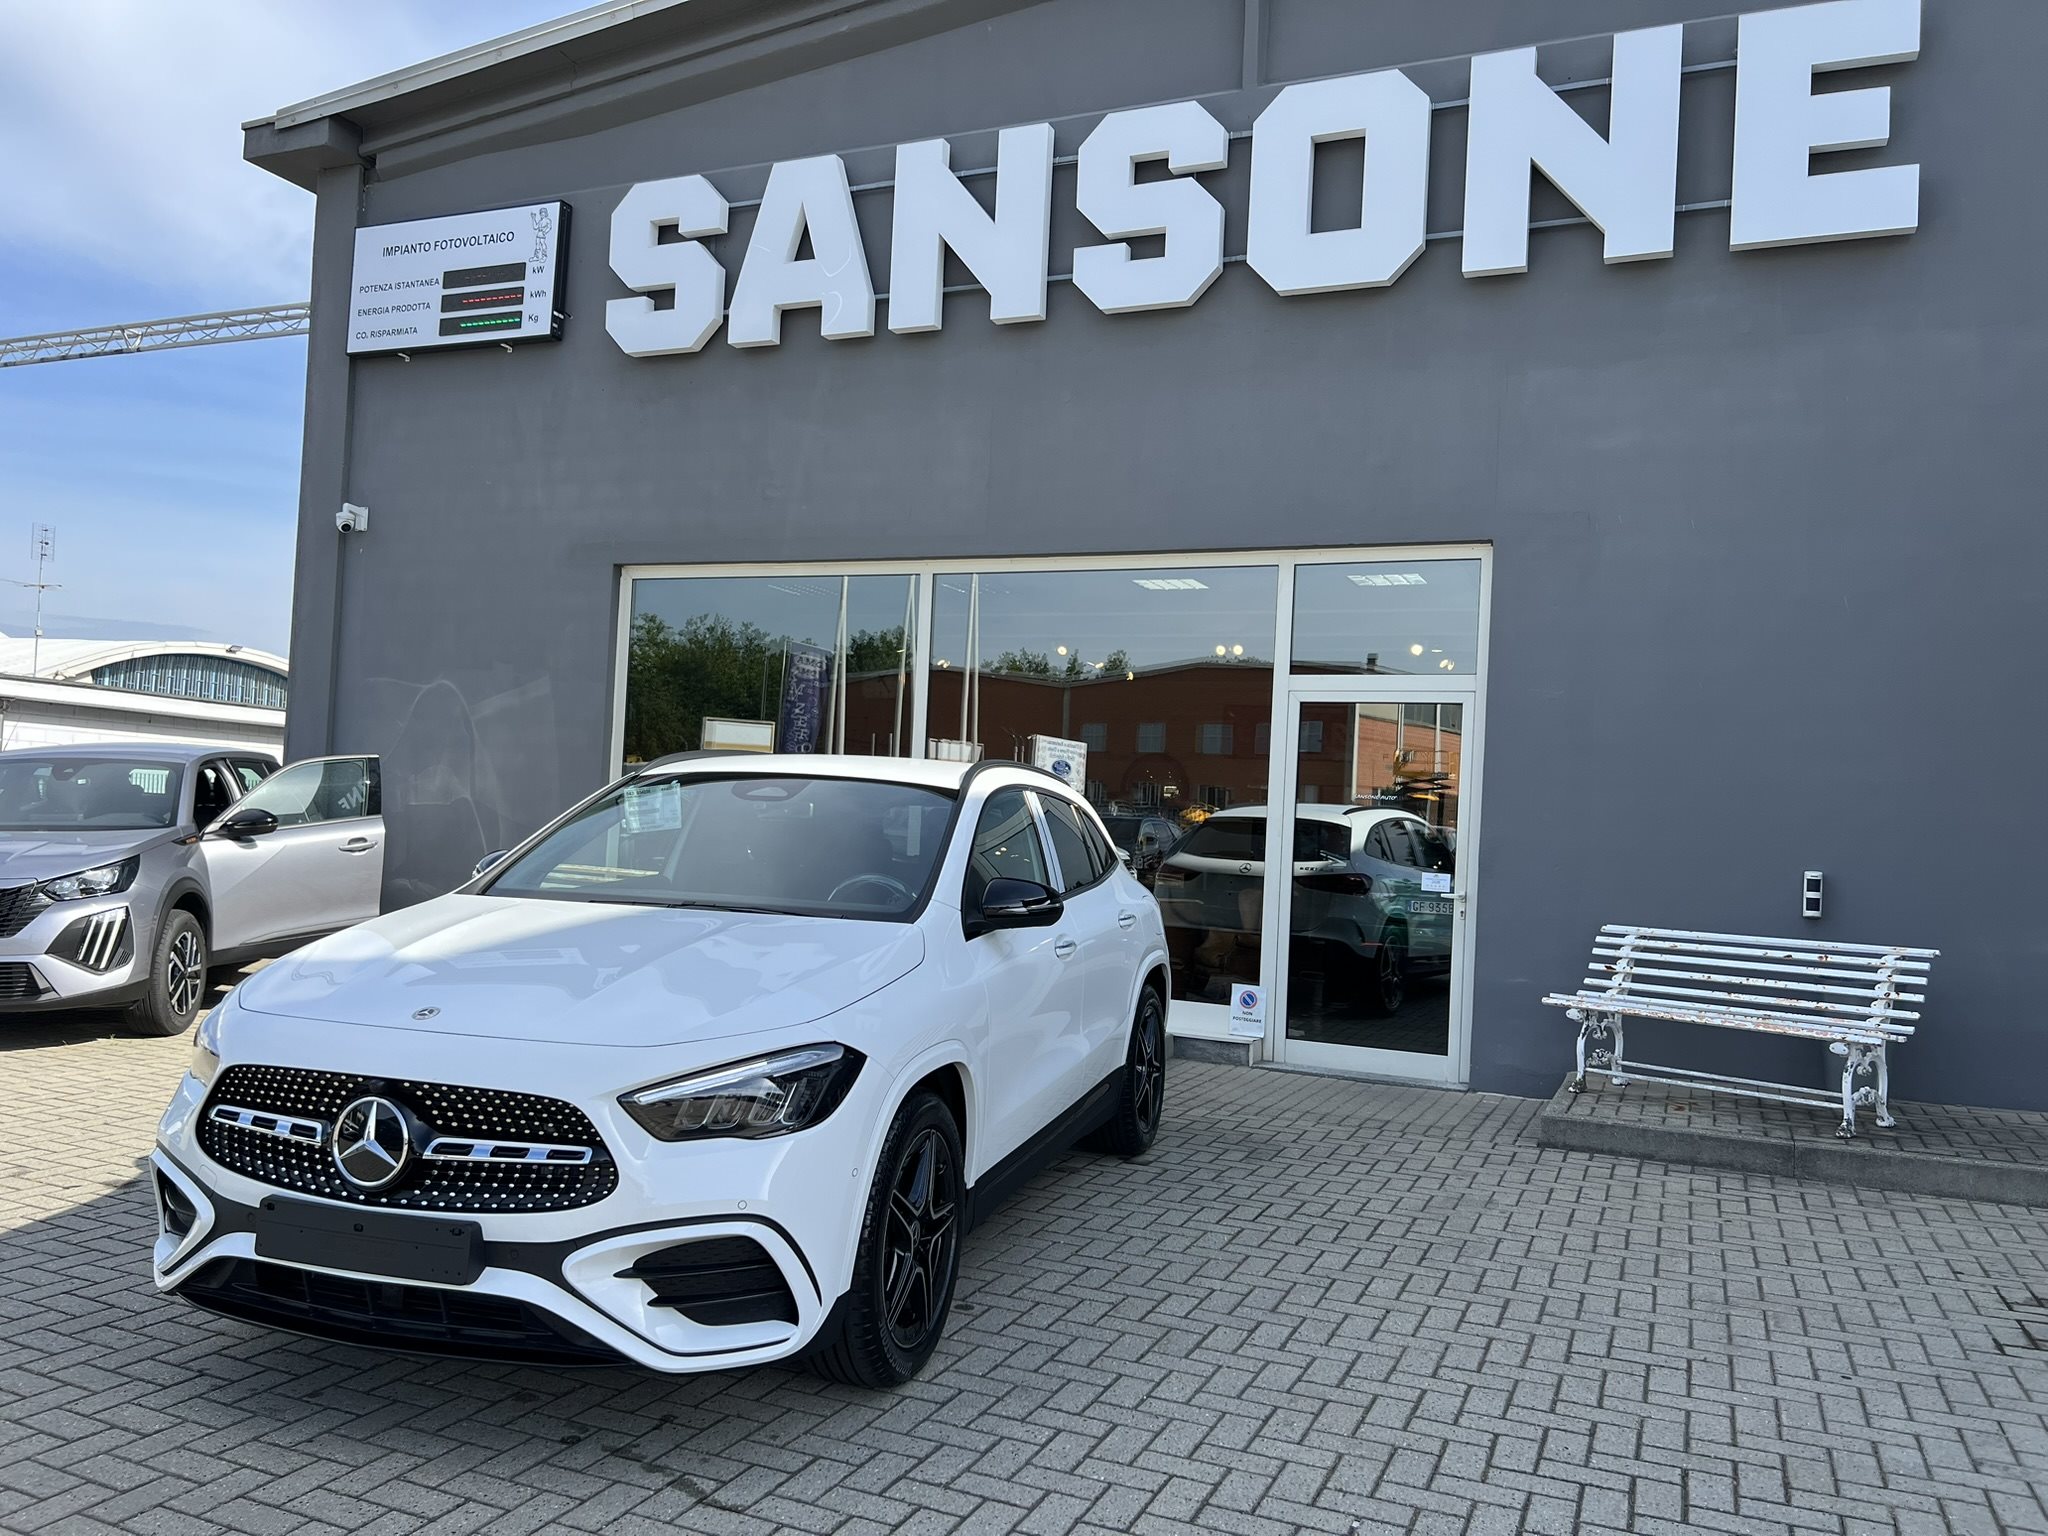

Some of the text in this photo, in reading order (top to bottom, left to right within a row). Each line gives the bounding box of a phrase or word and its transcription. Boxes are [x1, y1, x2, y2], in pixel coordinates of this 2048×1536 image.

[605, 0, 1922, 358] SANSONE
[382, 231, 515, 257] IMPIANTO FOTOVOLTAICO
[532, 265, 545, 274] kW
[359, 278, 440, 294] POTENZA ISTANTANEA
[530, 290, 547, 299] kWh
[357, 302, 431, 317] ENERGIA PRODOTTA
[528, 313, 539, 323] Kg
[370, 326, 418, 338] RISPARMIATA
